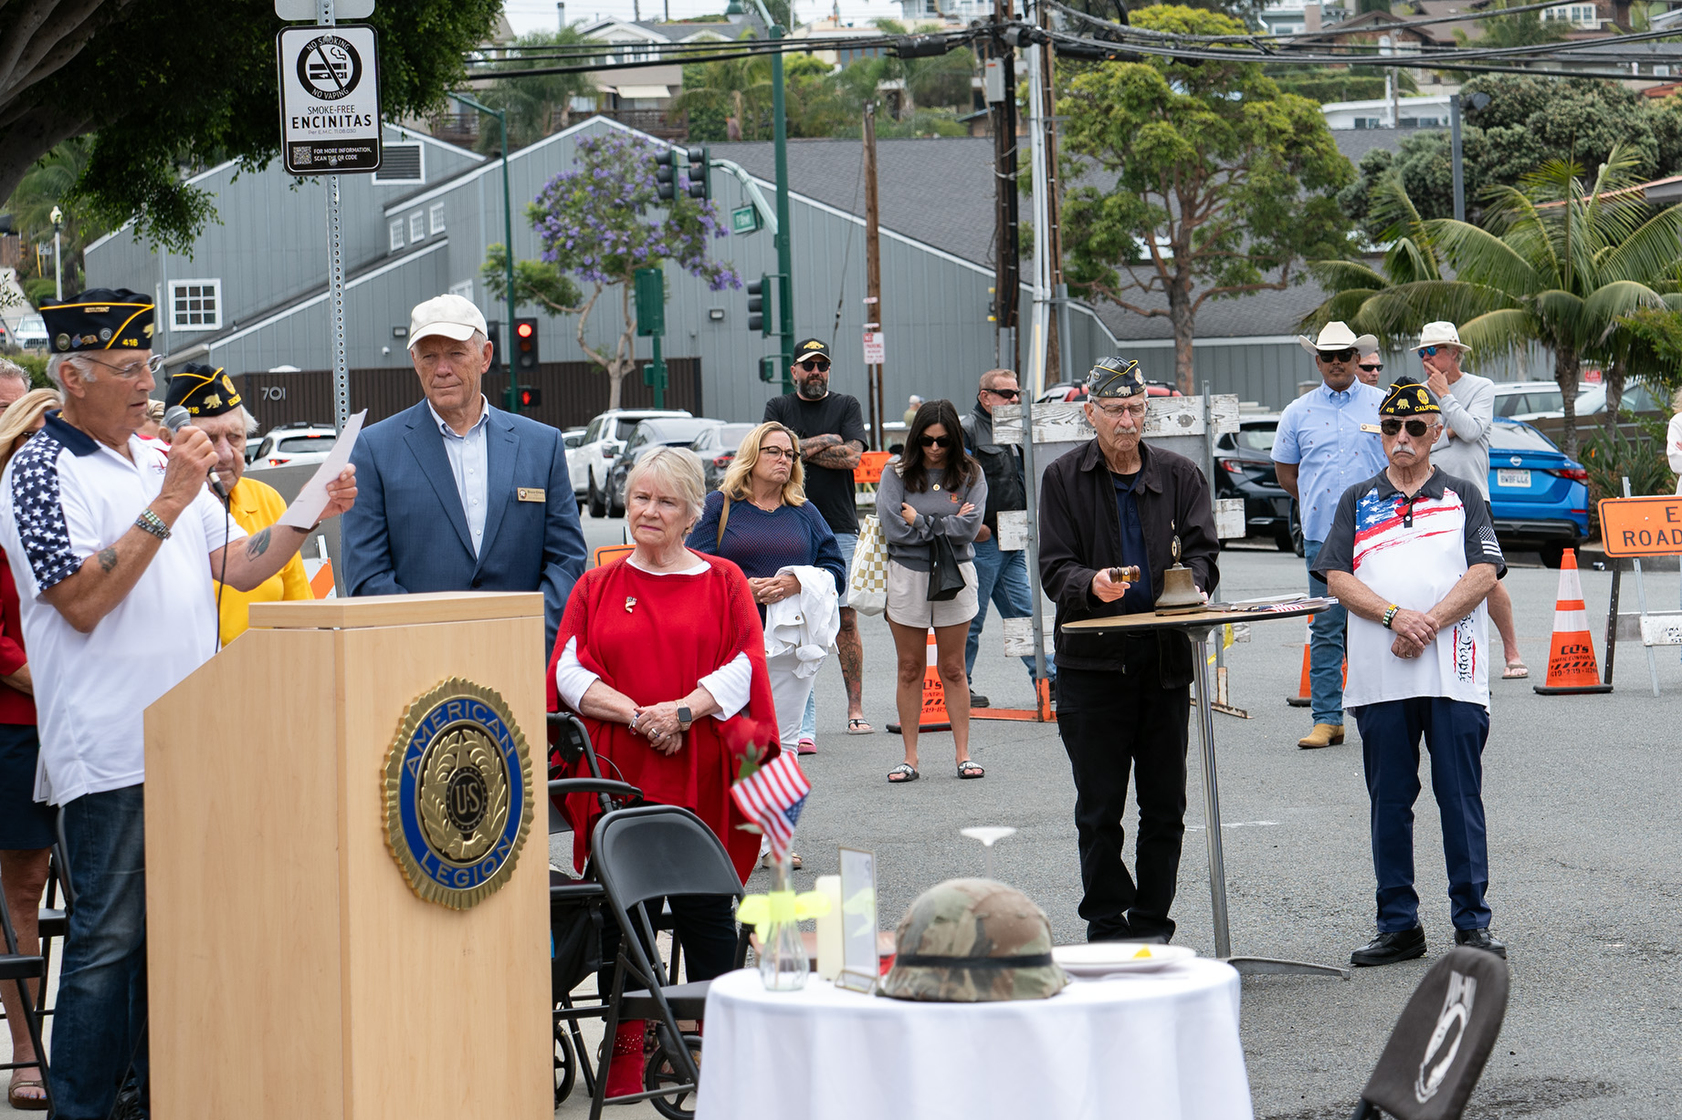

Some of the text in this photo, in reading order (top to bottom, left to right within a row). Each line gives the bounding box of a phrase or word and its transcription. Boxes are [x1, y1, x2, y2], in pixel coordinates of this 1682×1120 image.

[307, 41, 317, 51] NO
[312, 88, 349, 100] NO VAPING
[307, 105, 355, 115] SMOKE-FREE
[292, 114, 372, 129] ENCINITAS
[261, 386, 286, 401] 701
[1622, 529, 1682, 547] ROAD
[406, 700, 514, 779] AMERICAN
[420, 835, 512, 888] LEGION
